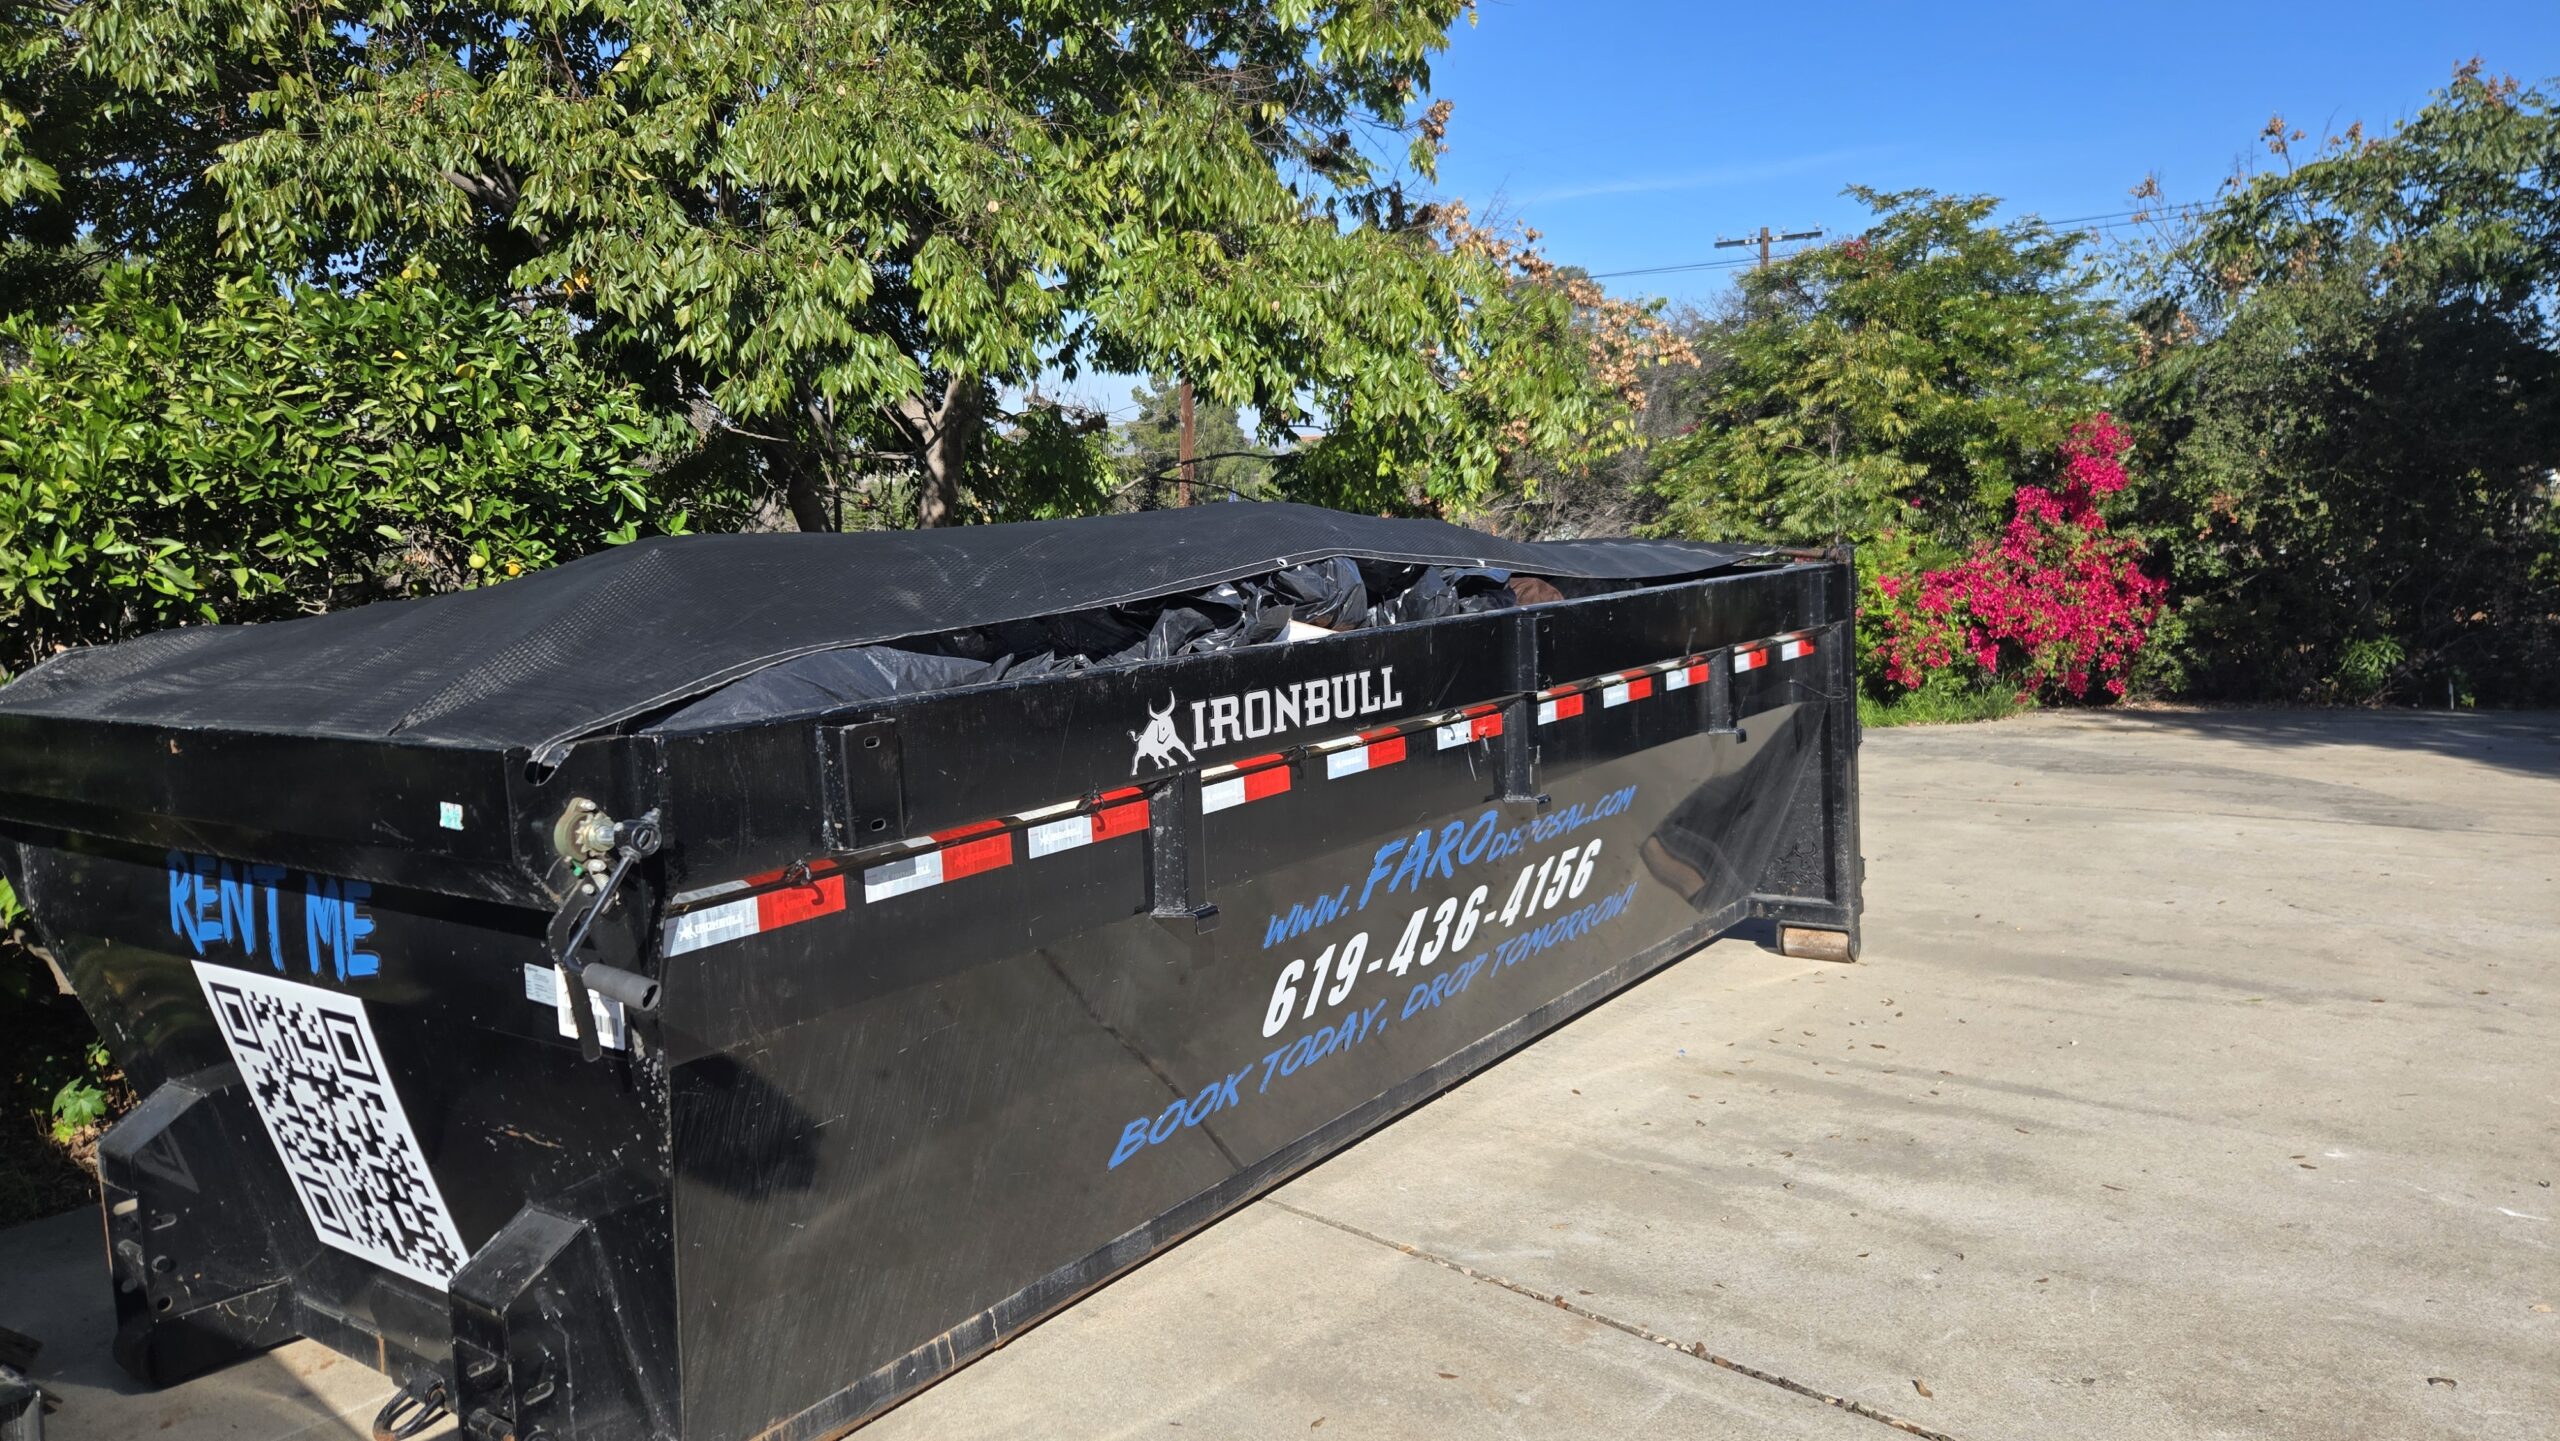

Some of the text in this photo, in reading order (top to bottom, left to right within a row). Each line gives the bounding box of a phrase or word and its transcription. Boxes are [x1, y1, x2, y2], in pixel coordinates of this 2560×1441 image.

[1190, 665, 1403, 751] IRONBULL
[165, 851, 382, 985] RENT ME
[1262, 838, 1602, 1038] 619-436-4156
[1106, 881, 1638, 1171] BOOK TODAY, DROP TOMORROW!
